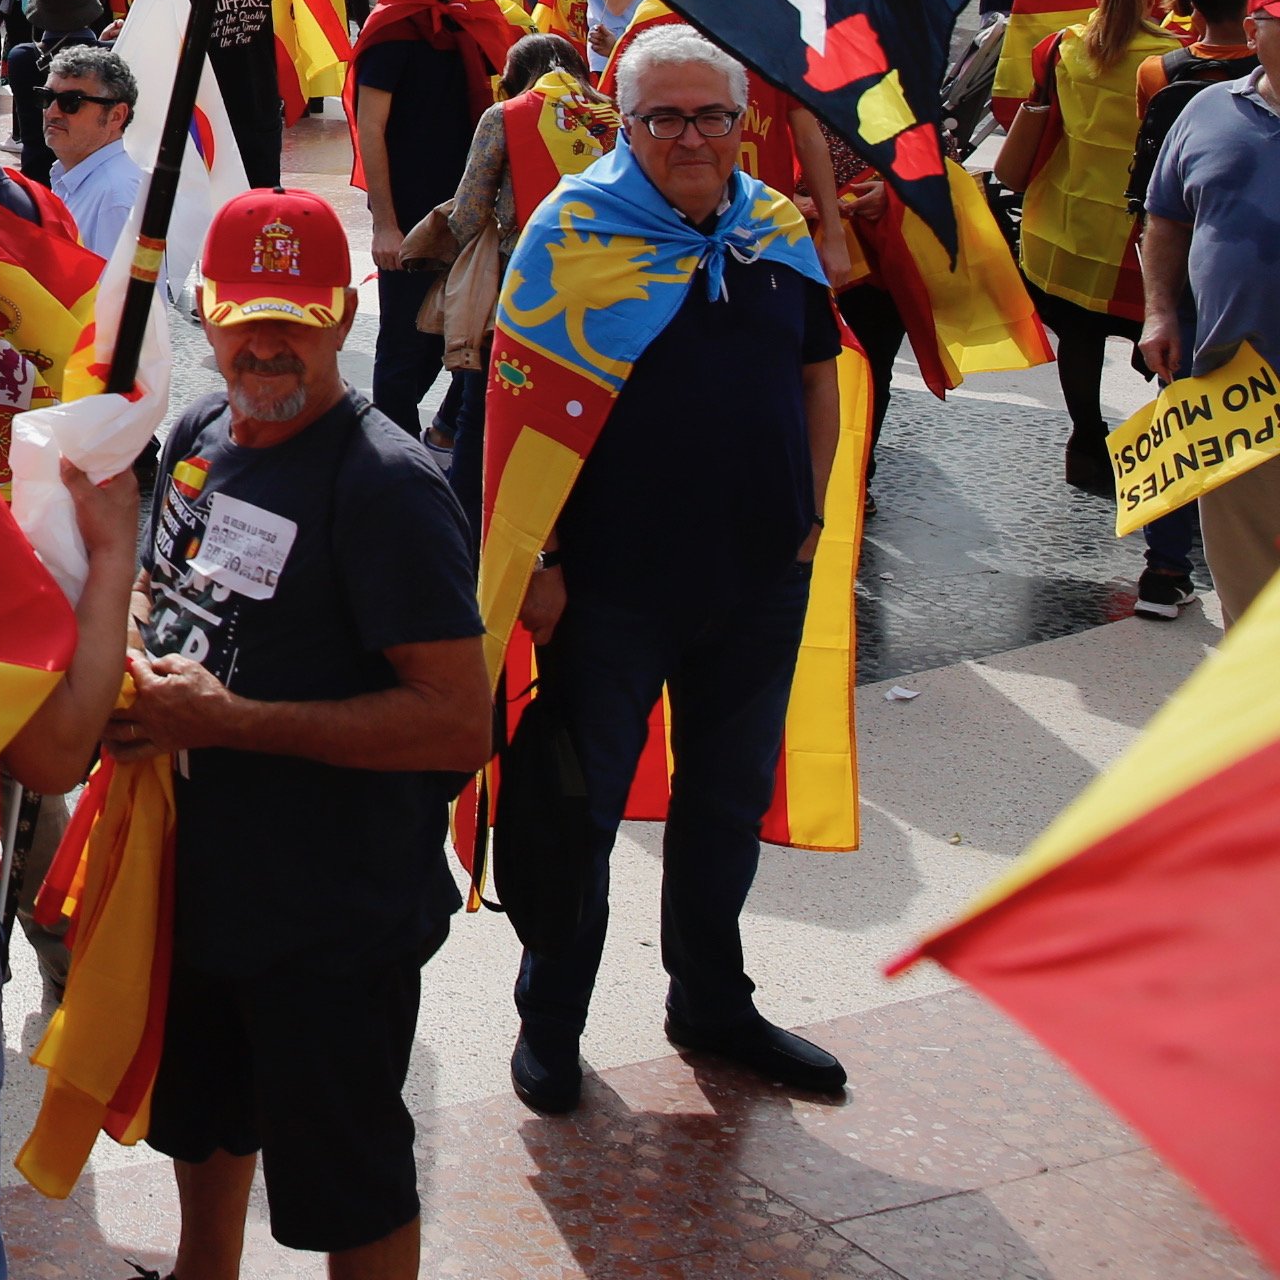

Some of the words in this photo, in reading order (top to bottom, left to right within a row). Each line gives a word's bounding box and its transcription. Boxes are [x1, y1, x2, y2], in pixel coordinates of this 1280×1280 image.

[1222, 366, 1277, 412] NO
[1114, 394, 1213, 479] MUROS!
[1120, 415, 1275, 512] PUENTES,
